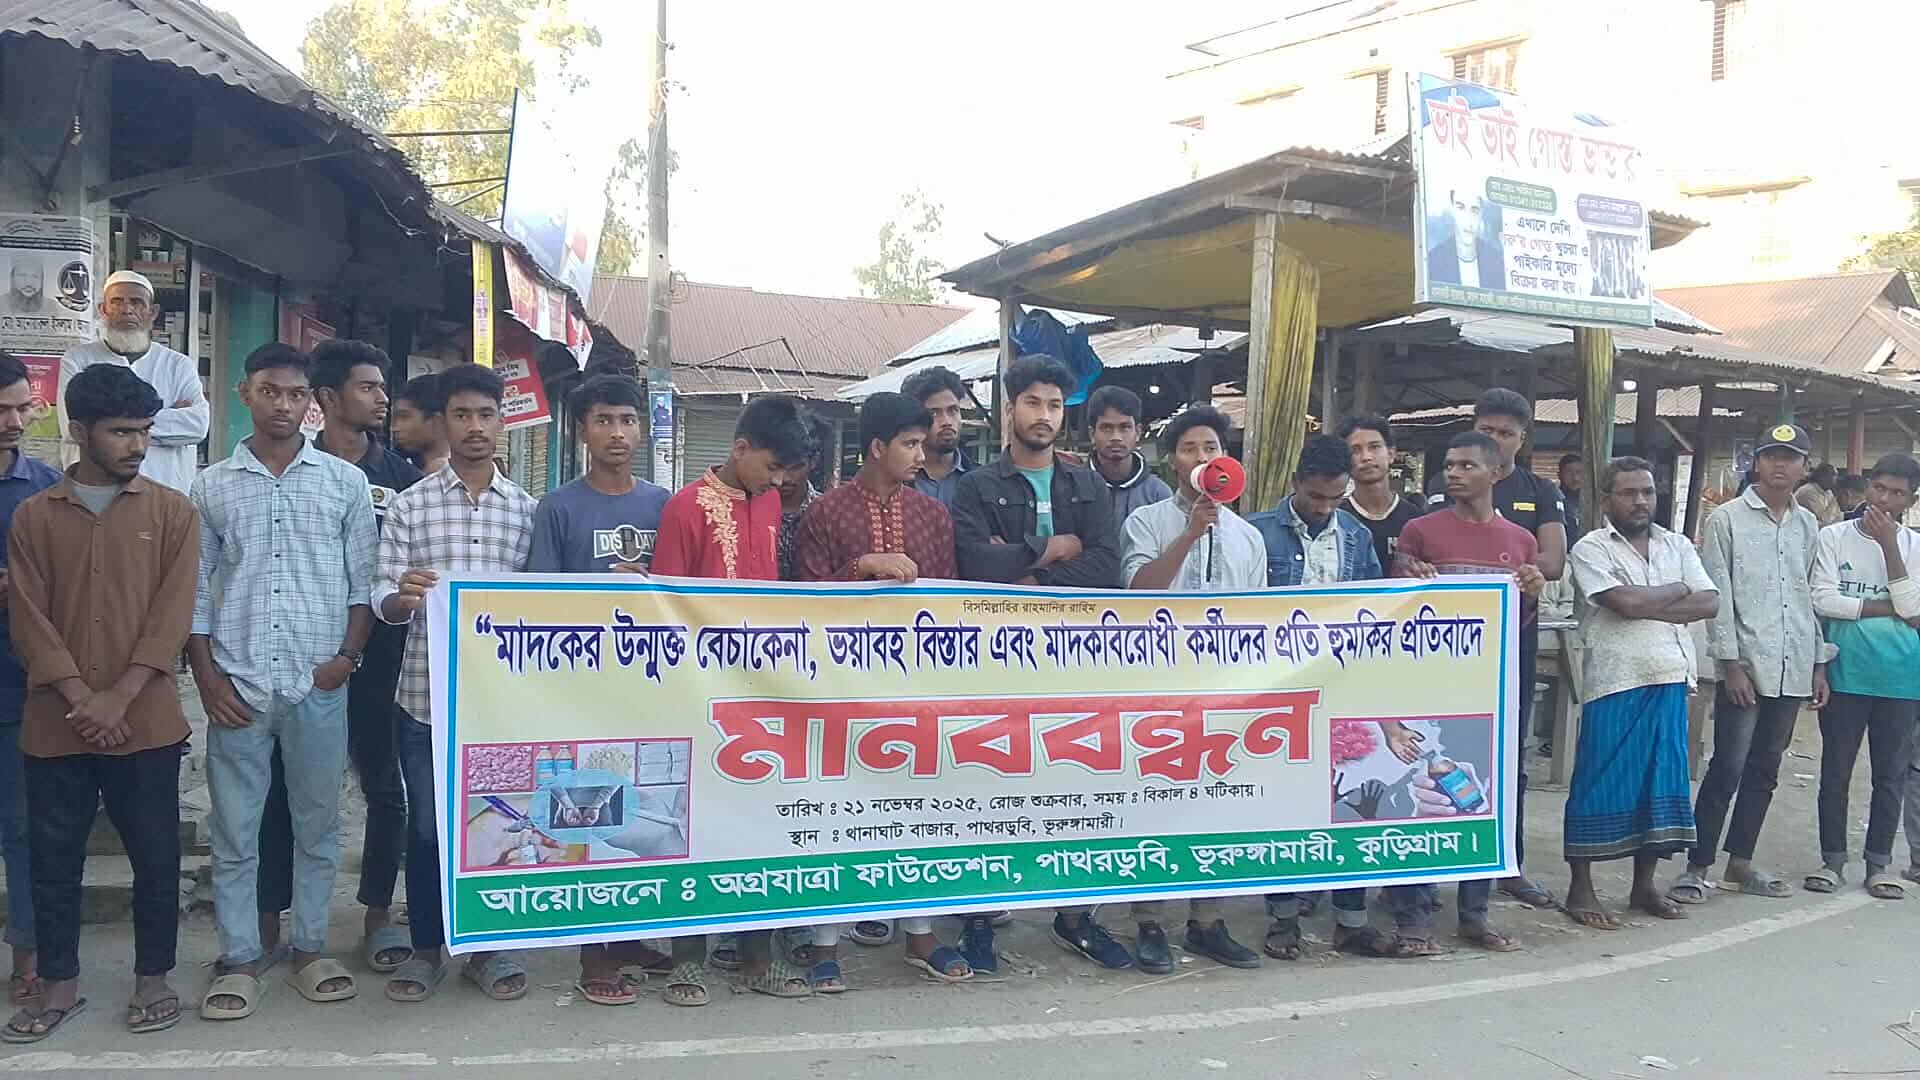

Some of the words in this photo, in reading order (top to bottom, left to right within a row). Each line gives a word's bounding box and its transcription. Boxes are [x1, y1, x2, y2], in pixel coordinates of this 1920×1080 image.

[599, 533, 657, 551] DISLAY
[1837, 580, 1890, 595] ETIHA
[612, 608, 687, 684] উন্মুক্ত
[696, 619, 817, 680] বেচাকেনা,
[826, 620, 908, 677] ভয়াবহ
[913, 610, 981, 671] বিস্তার
[991, 624, 1038, 671] এবং
[1042, 607, 1177, 672] মাদকবিরোধী
[1184, 606, 1268, 666] কর্মীদের
[1274, 608, 1320, 665] প্রতি
[1324, 608, 1396, 669] হুমকির
[1400, 604, 1485, 660] প্রতিবাদে
[712, 689, 1321, 782] মানববন্ধন
[776, 799, 823, 818] তারিখ
[843, 800, 865, 815] ২১
[870, 797, 925, 813] নভেম্বর
[930, 797, 982, 812] ২০২৫,
[989, 794, 1025, 809] রোজ
[1031, 793, 1087, 809] শুক্রবার,
[1093, 791, 1127, 806] সময়
[1143, 786, 1185, 803] বিকাল
[788, 828, 820, 848] স্থান
[845, 821, 905, 842] থানাঘাট
[909, 821, 959, 838] বাজার,
[967, 817, 1036, 836] পাথরডুবি,
[477, 877, 668, 917] আয়োজনে
[707, 861, 844, 898] অগ্রযাত্রা
[852, 853, 1023, 888] ফাউন্ডেশন,
[1035, 839, 1180, 880] পাথরডুবি,
[1189, 831, 1345, 876] ভূরুঙ্গামারী,
